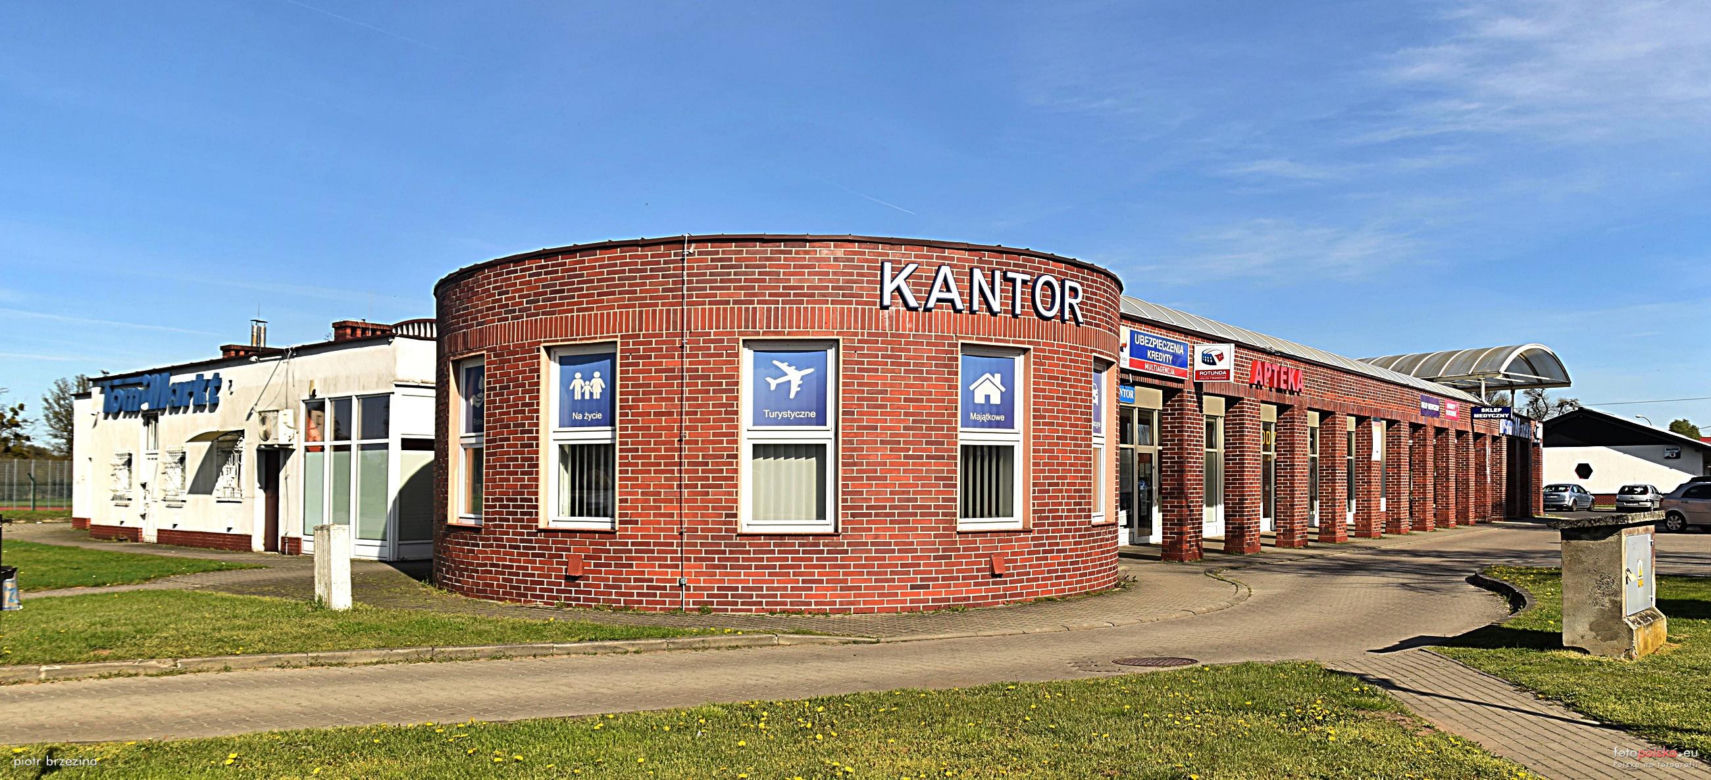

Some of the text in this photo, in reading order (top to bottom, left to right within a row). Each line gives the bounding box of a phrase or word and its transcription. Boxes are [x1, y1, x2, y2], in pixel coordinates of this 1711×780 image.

[879, 261, 1084, 326] KANTOR
[1134, 333, 1184, 355] UBEZPIECZENIA
[1147, 350, 1173, 364] KREDYTY
[1250, 360, 1304, 393] APTEKA
[572, 411, 603, 422] Na życie
[763, 409, 817, 420] Turystyczne
[970, 411, 1005, 422] Majątkowe
